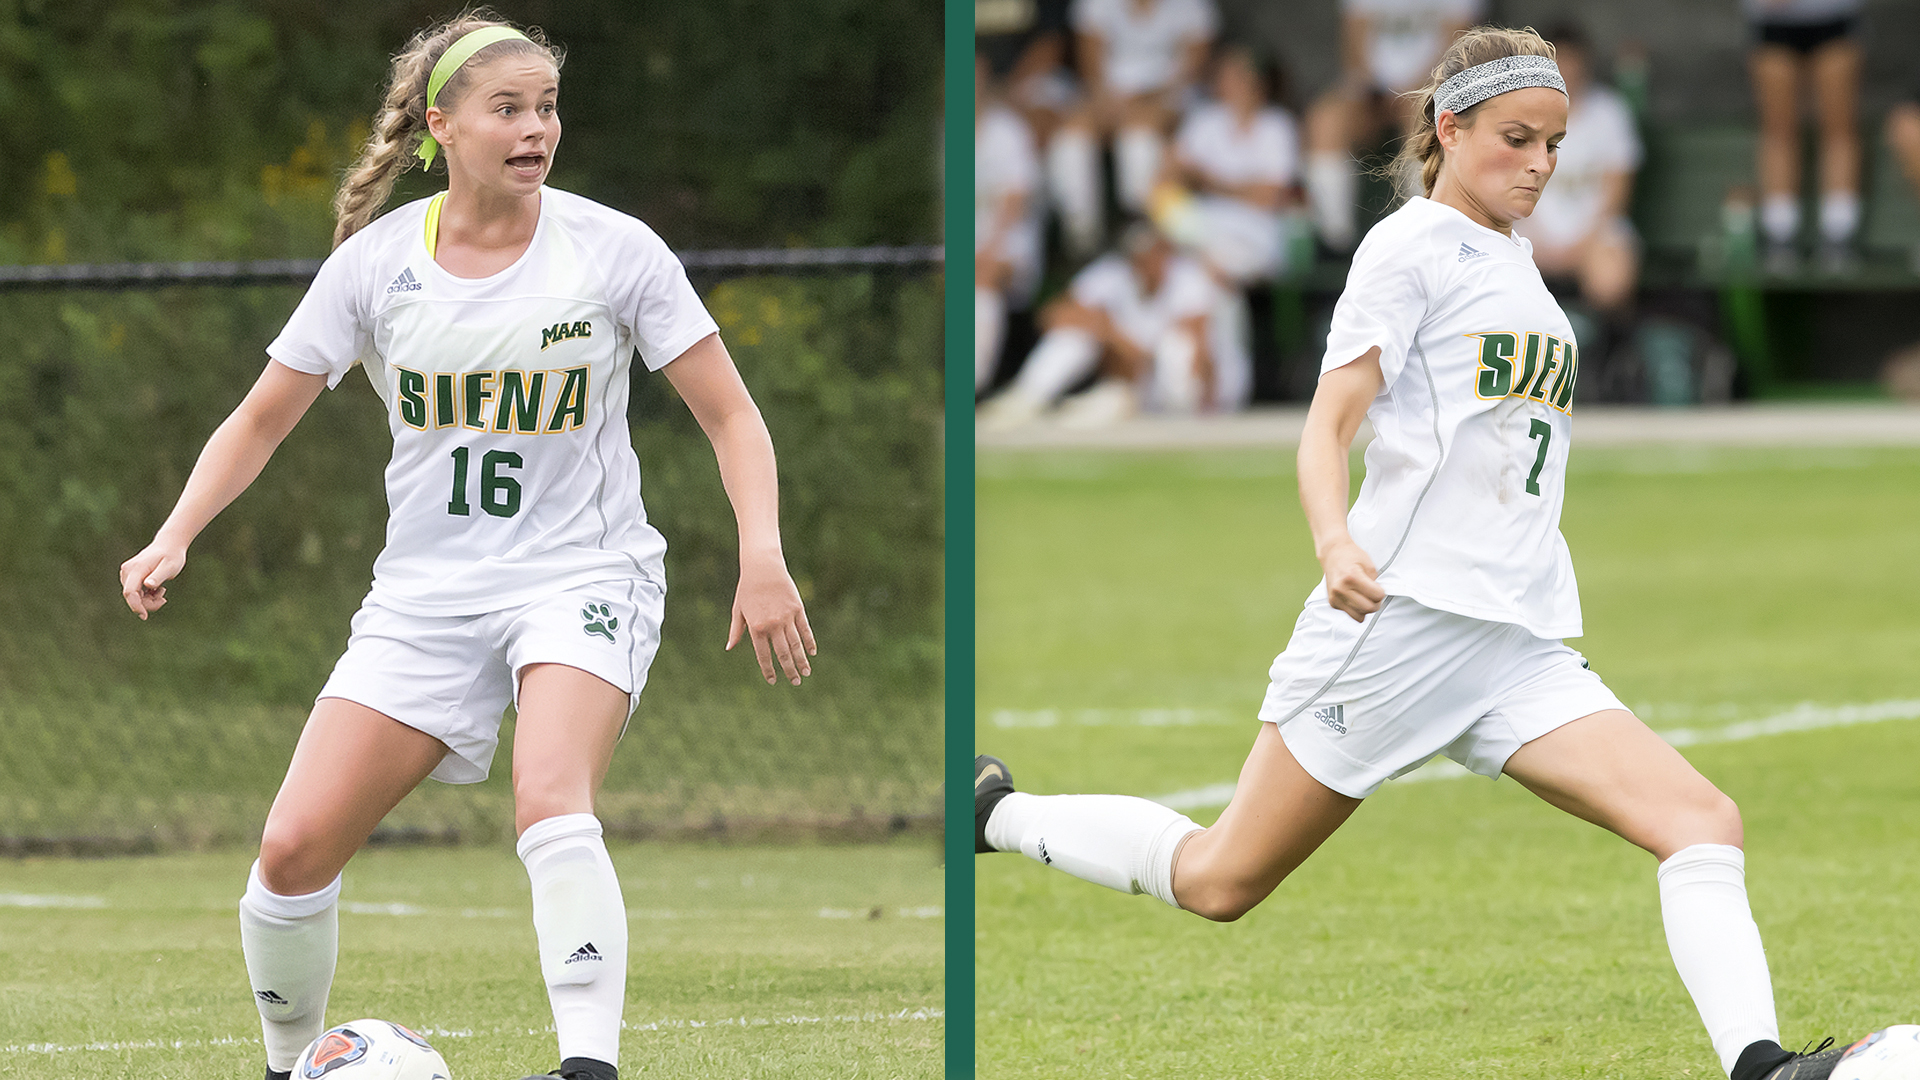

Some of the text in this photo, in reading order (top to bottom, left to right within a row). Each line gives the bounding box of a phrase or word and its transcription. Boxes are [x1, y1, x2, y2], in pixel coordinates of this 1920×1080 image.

[386, 282, 422, 294] adidas
[540, 320, 592, 353] MAAC
[389, 363, 591, 435] SIENA
[1462, 331, 1579, 417] SIEN
[447, 446, 523, 518] 16
[1525, 417, 1552, 497] 7
[1314, 711, 1348, 735] adidas
